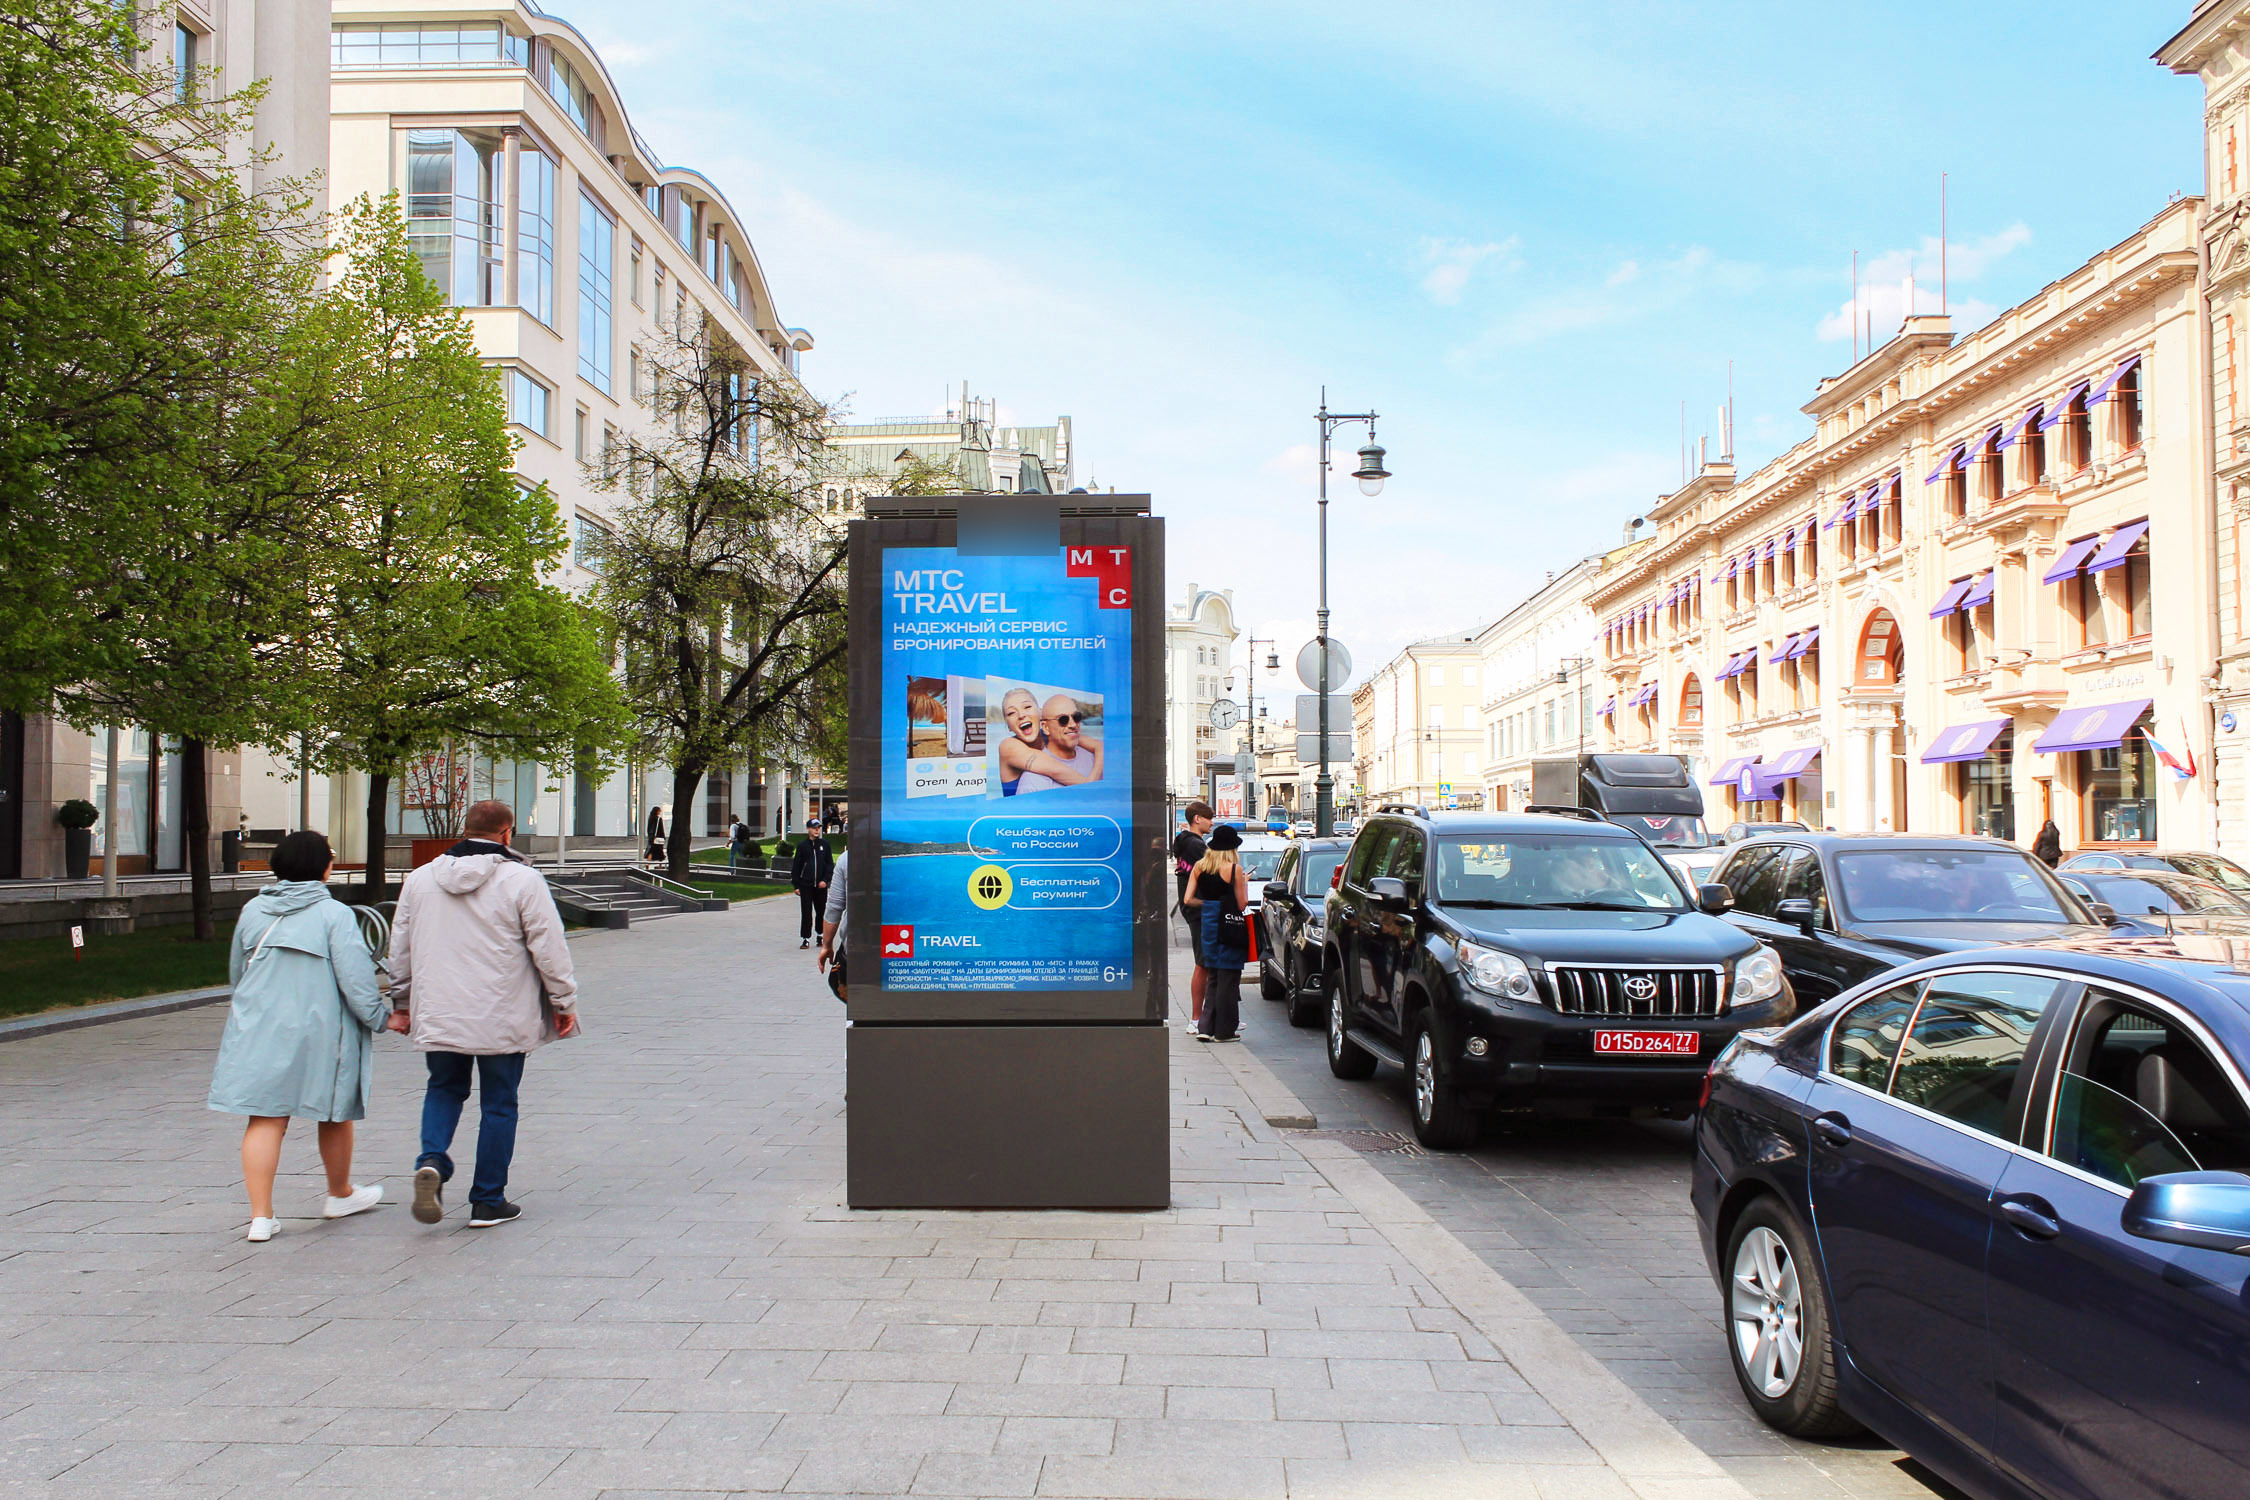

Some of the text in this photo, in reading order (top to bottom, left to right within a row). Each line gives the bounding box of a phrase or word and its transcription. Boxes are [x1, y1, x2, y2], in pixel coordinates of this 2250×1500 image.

[893, 592, 1018, 614] TRAVEL
[893, 618, 1068, 635] НАДЕЖНЫЙ СЕРВИС
[893, 634, 1106, 651] БРОНИРОВАНИЯ ОТЕЛЕЙ
[996, 827, 1095, 837] Кешбэк до 10%
[1011, 840, 1079, 849] по России
[1020, 877, 1100, 886] Бесплатный
[1032, 891, 1088, 900] роуминг
[919, 935, 982, 947] TRAVEL
[1103, 966, 1128, 983] 6+
[1675, 1033, 1692, 1046] 77
